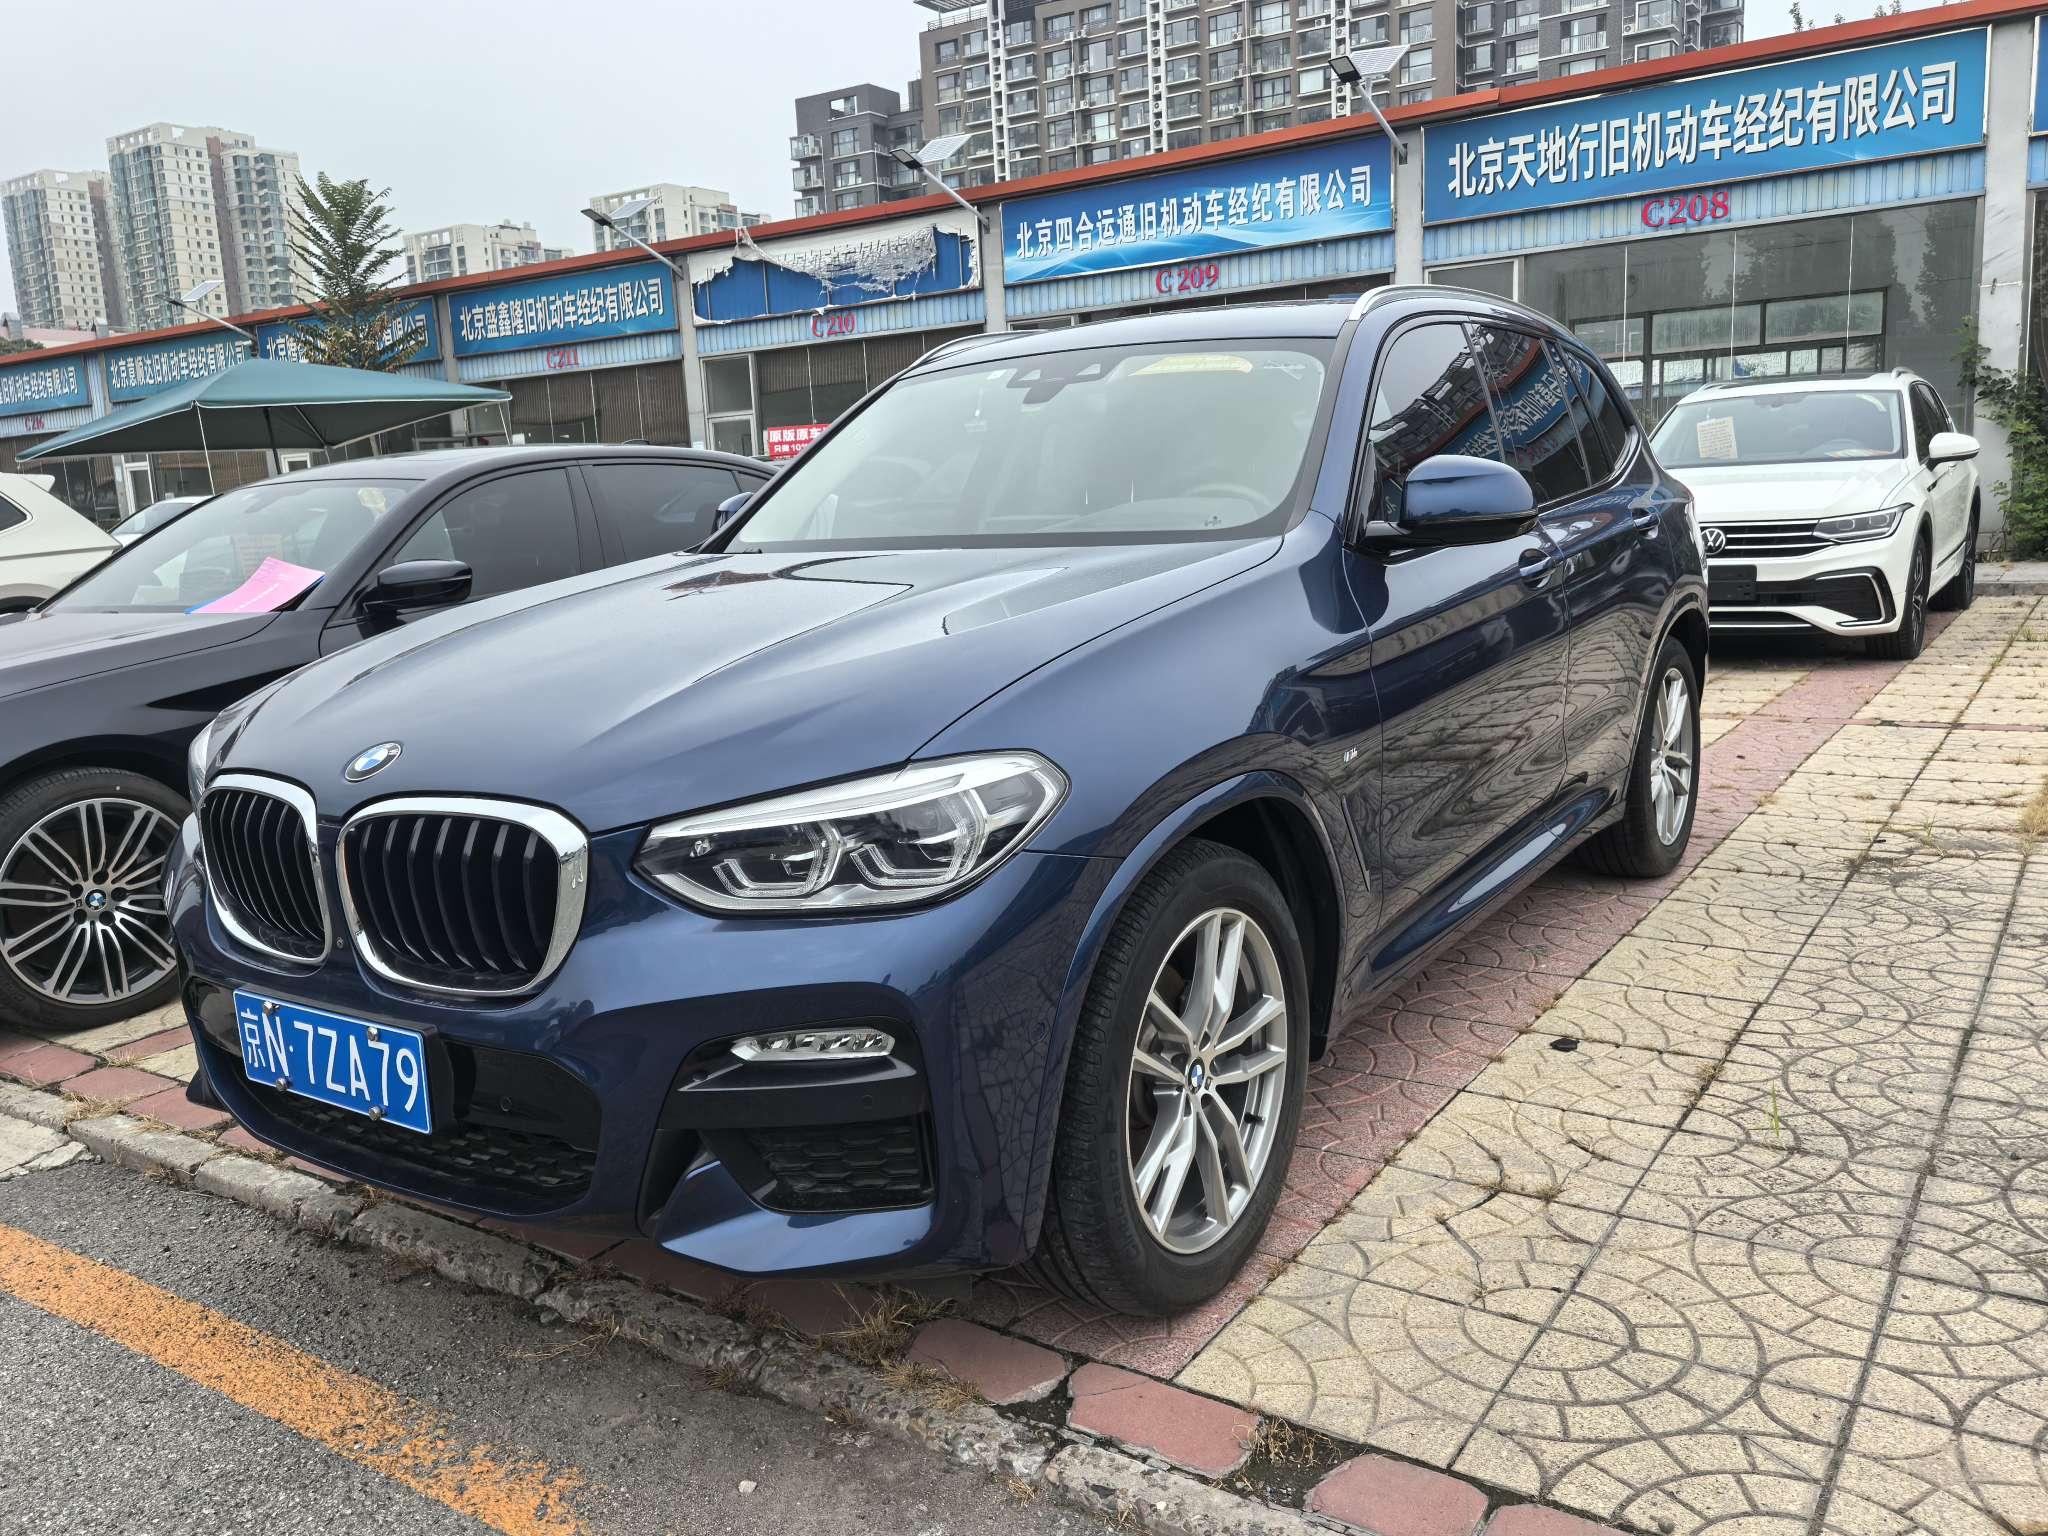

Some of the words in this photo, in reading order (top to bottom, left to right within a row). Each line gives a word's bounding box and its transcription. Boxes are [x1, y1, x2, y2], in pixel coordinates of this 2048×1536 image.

[1447, 61, 1958, 199] 北京天地行旧机动车经纪有限公司
[1016, 165, 1373, 260] 北京四合运通旧机动车经纪有限公司
[1641, 191, 1729, 228] C208
[460, 277, 665, 342] 北京盛鑫隆旧机动车经纪有限公司
[769, 427, 825, 442] 原版原车
[240, 1007, 419, 1113] 京N·7ZA79
